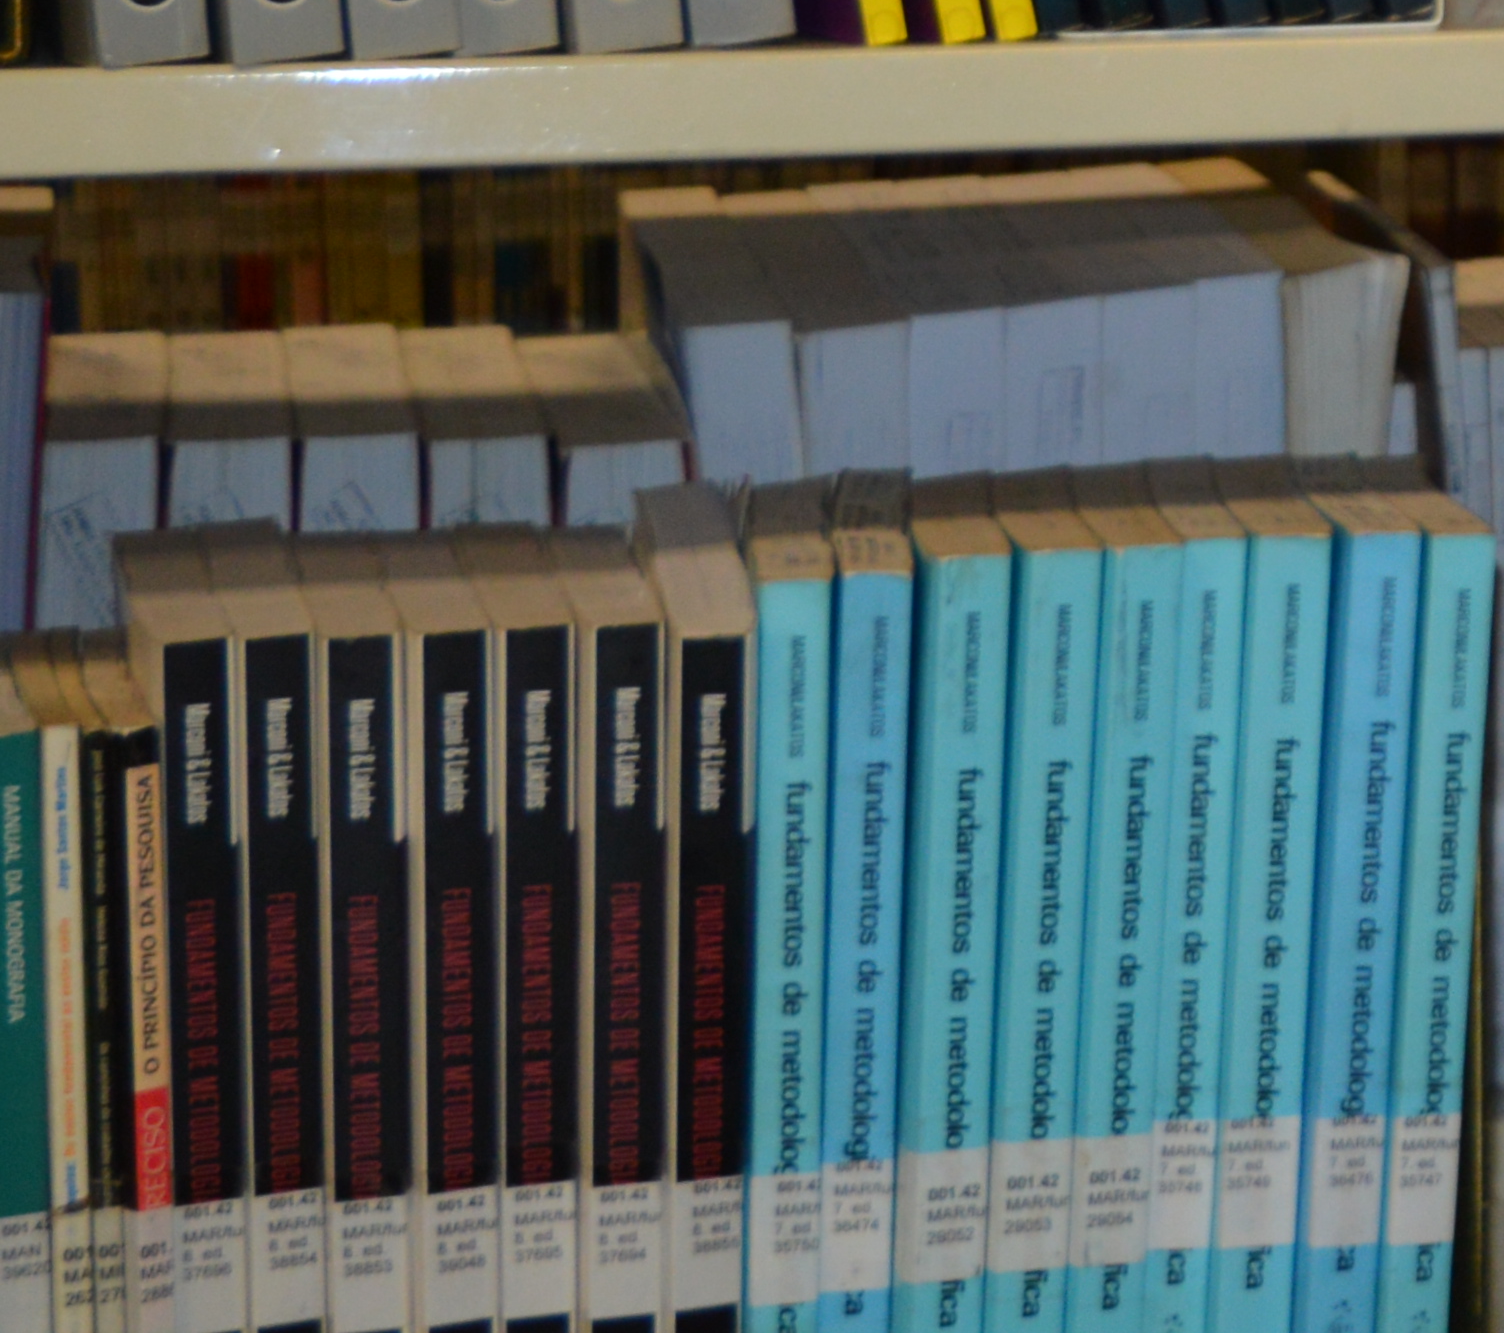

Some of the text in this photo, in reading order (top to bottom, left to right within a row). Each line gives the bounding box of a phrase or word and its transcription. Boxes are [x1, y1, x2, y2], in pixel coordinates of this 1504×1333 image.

[2, 784, 26, 1025] MANUAL DA MONOGRAFIA
[135, 774, 160, 1076] O PRINCÍPIO DA PESQUISA
[781, 781, 812, 1017] fundamentos de
[950, 767, 984, 1003] fundamentos de
[1037, 760, 1073, 995] fundamentos de
[1263, 736, 1300, 970] fundamentos de
[1435, 731, 1471, 963] fundamentos de
[265, 892, 298, 1064] FUNDAMENTOS DE
